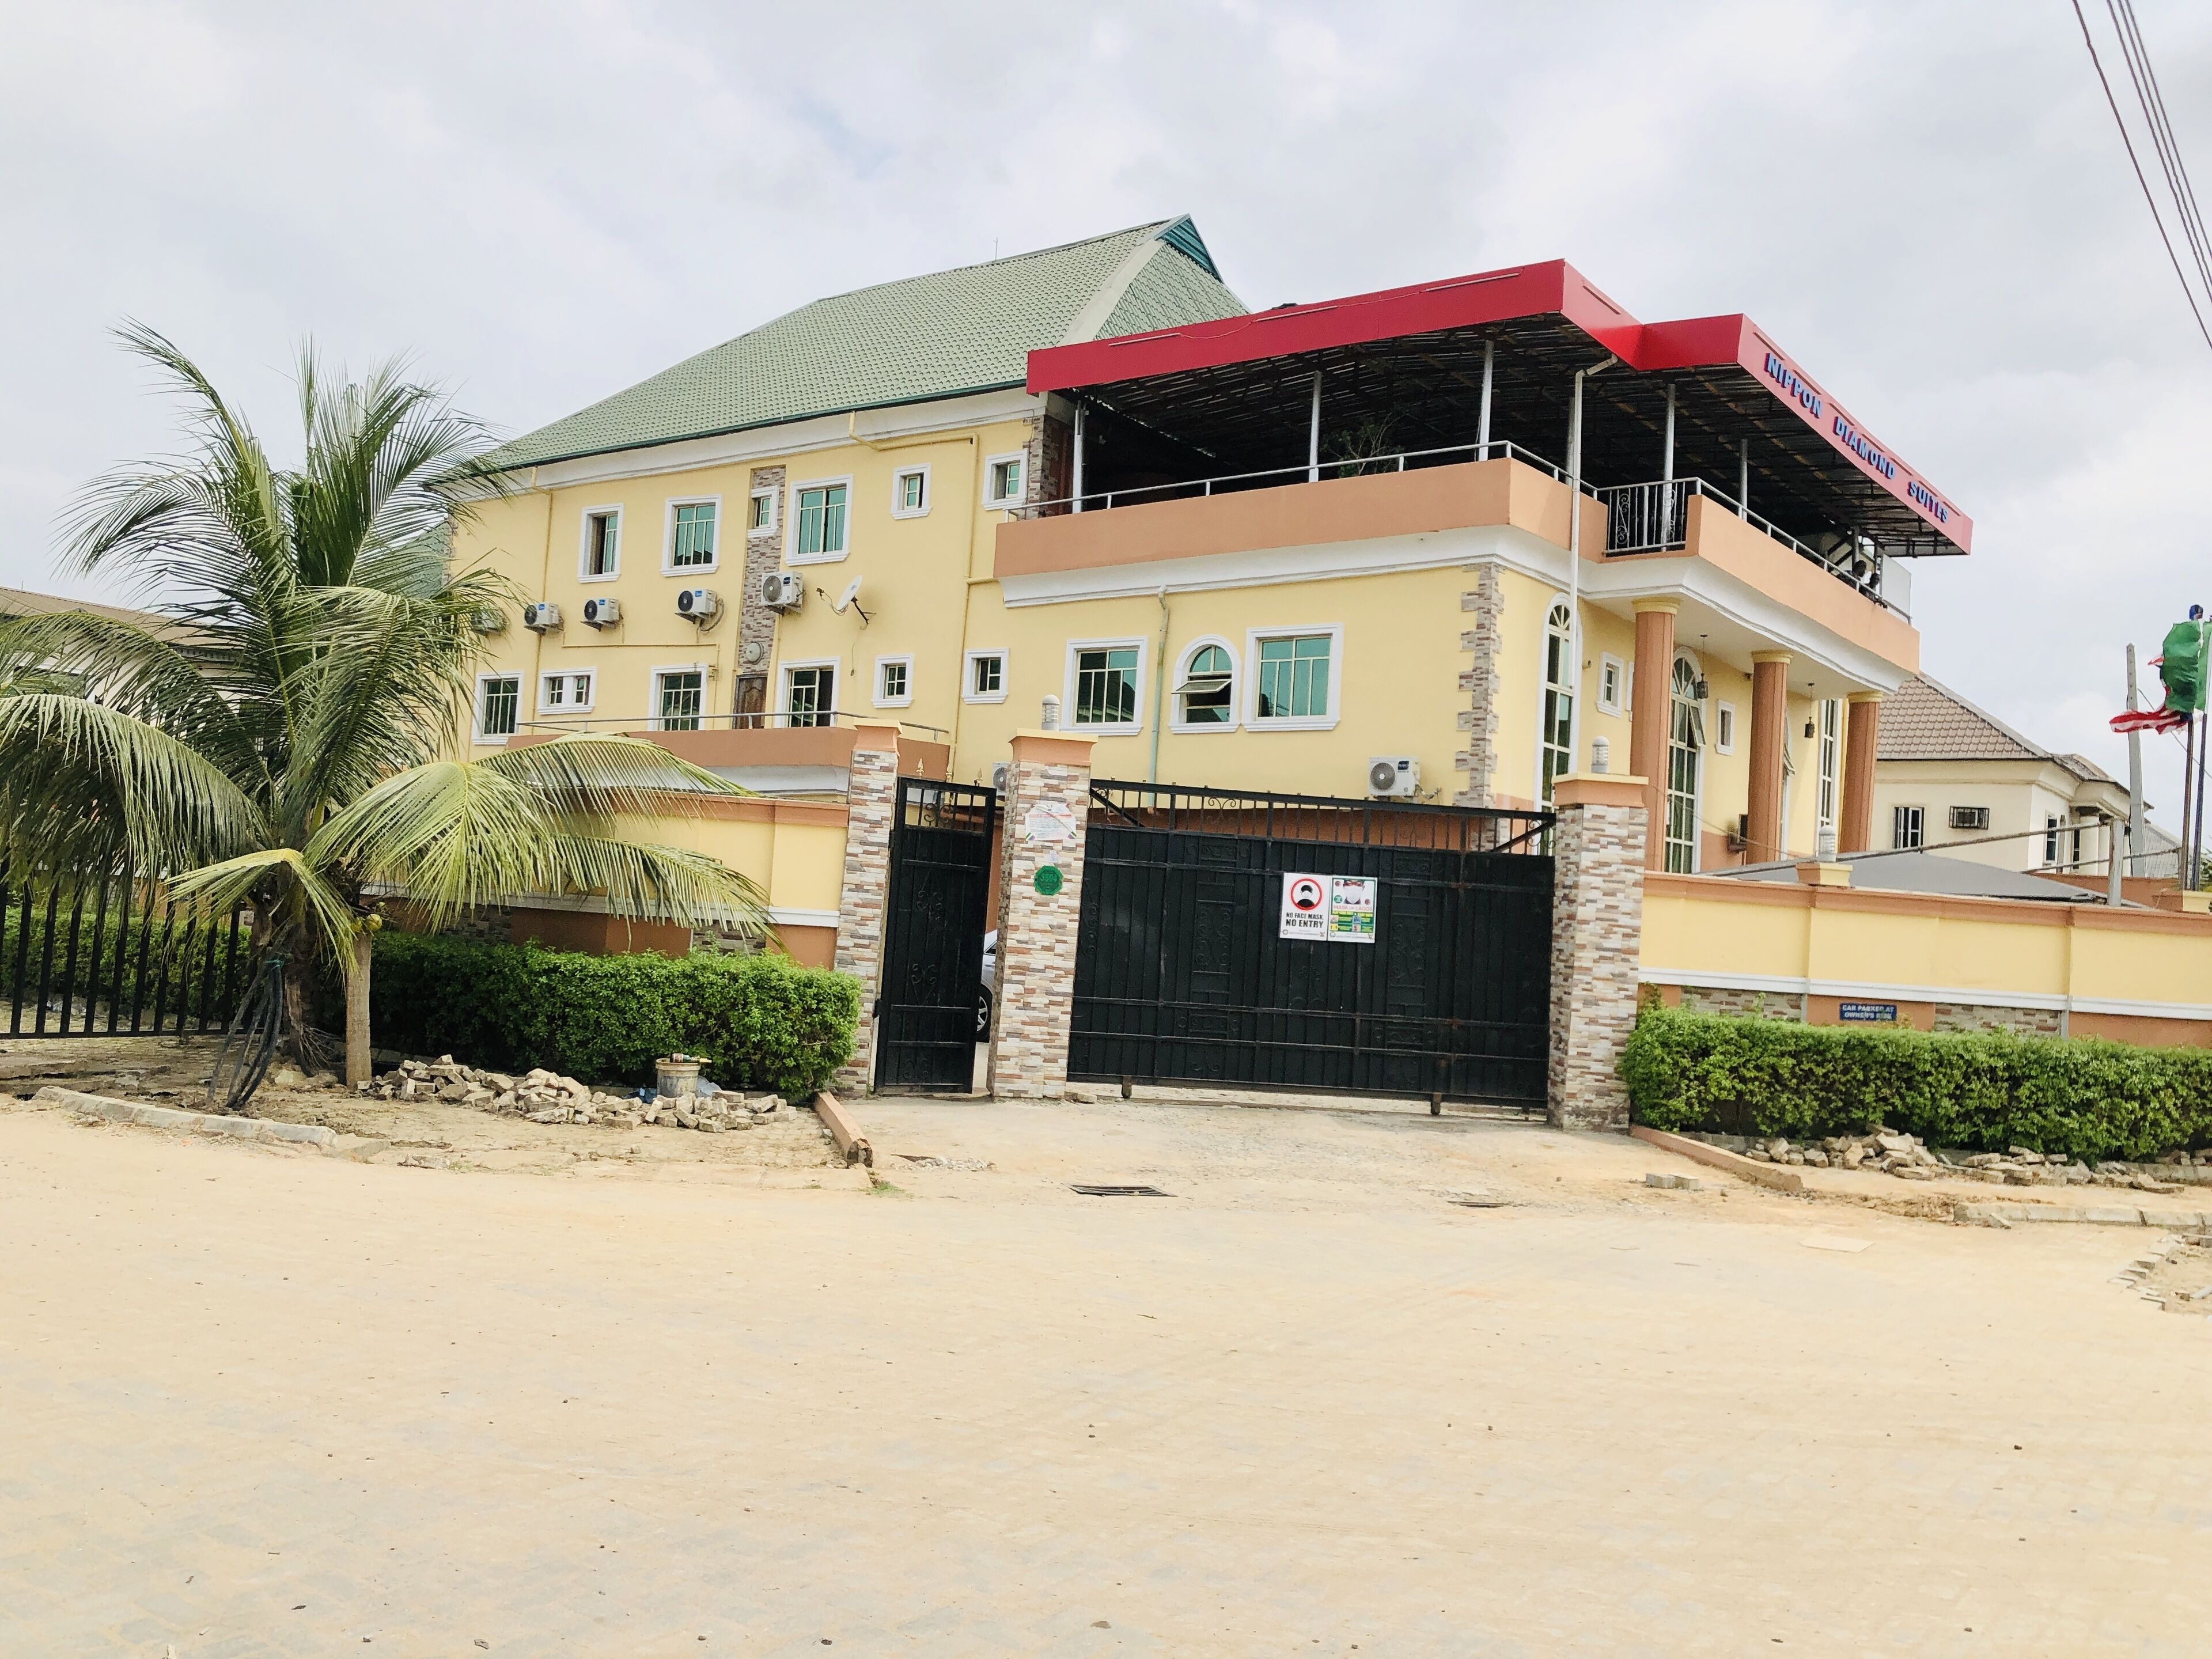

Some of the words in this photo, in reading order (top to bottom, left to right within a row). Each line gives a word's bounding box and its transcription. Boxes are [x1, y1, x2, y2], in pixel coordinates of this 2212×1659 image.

[1764, 353, 1823, 419] NIPPON
[1833, 416, 1896, 480] DIAMOND
[1907, 481, 1949, 523] SUITES
[1298, 919, 1324, 928] ENTRY
